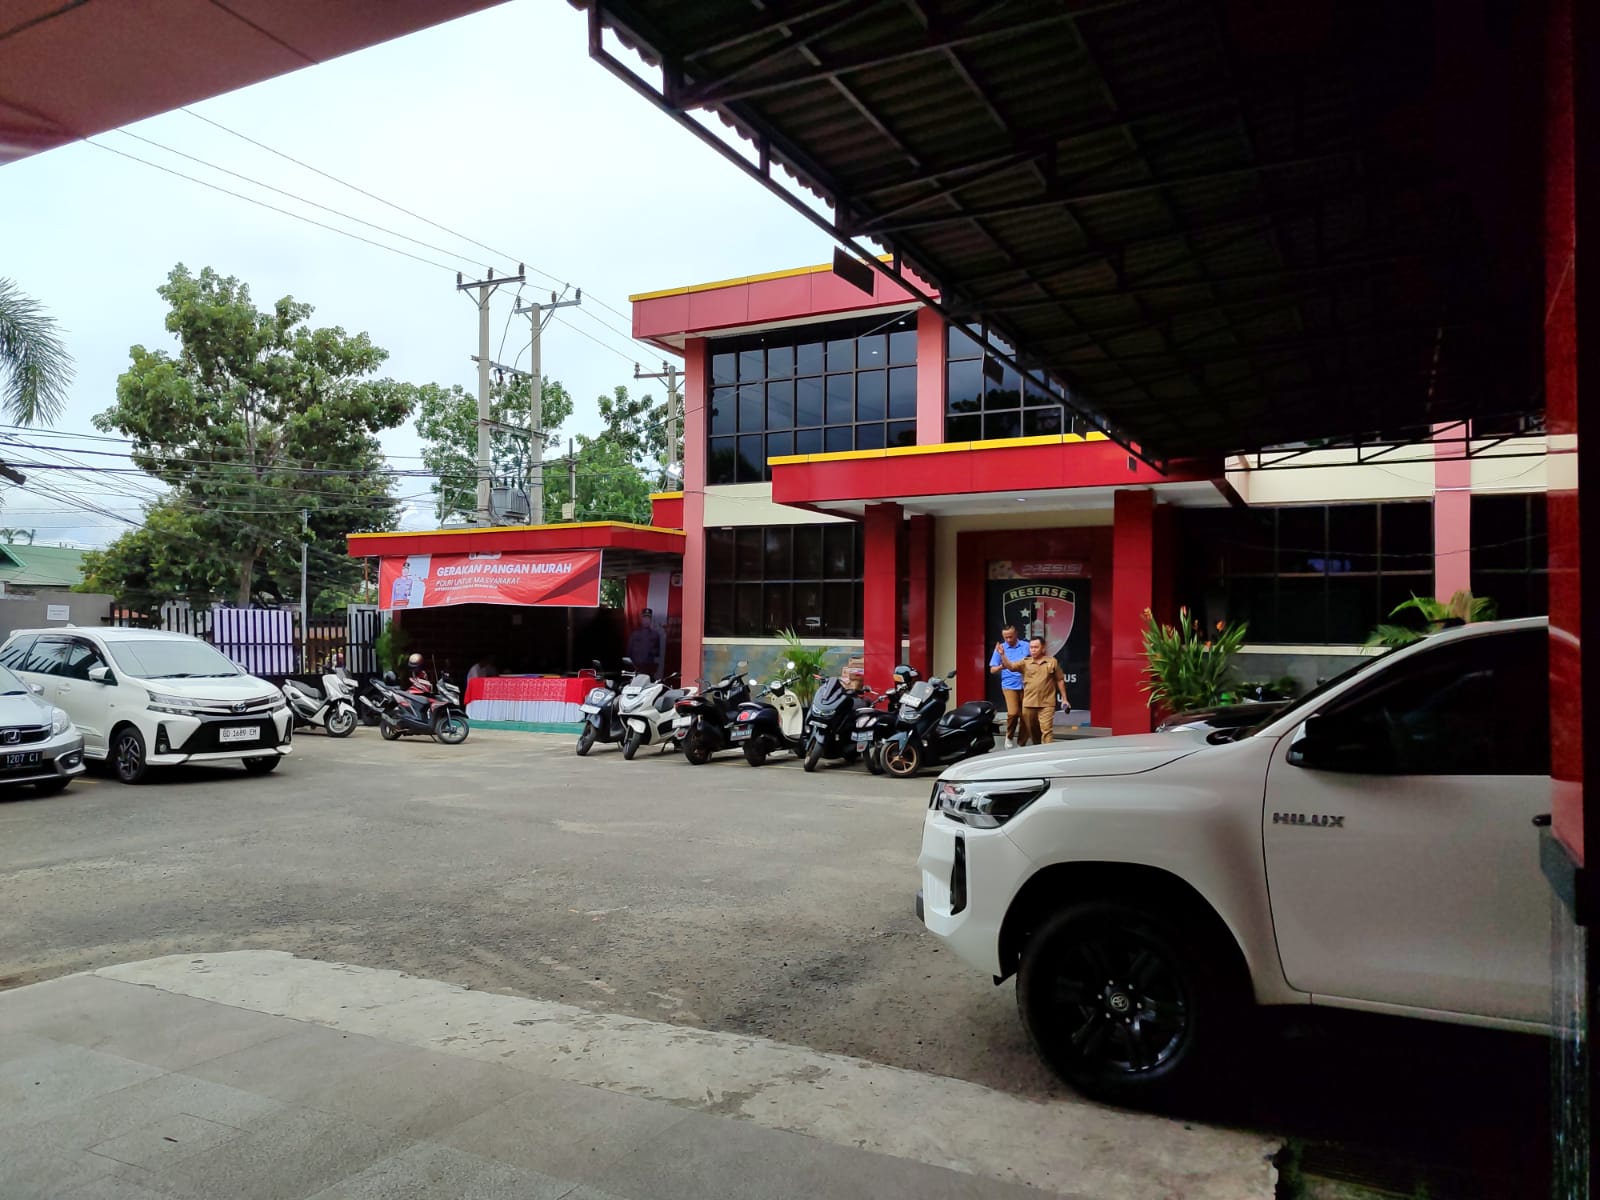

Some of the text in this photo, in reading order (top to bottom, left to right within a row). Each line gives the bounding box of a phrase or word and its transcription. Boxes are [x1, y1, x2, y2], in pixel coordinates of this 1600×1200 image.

[437, 563, 571, 576] GERAKAN PANGAN MURAH
[474, 577, 520, 585] MASYARAKAT
[1010, 587, 1068, 599] RESERSE
[7, 753, 25, 764] 1207
[1273, 812, 1345, 827] HILUX
